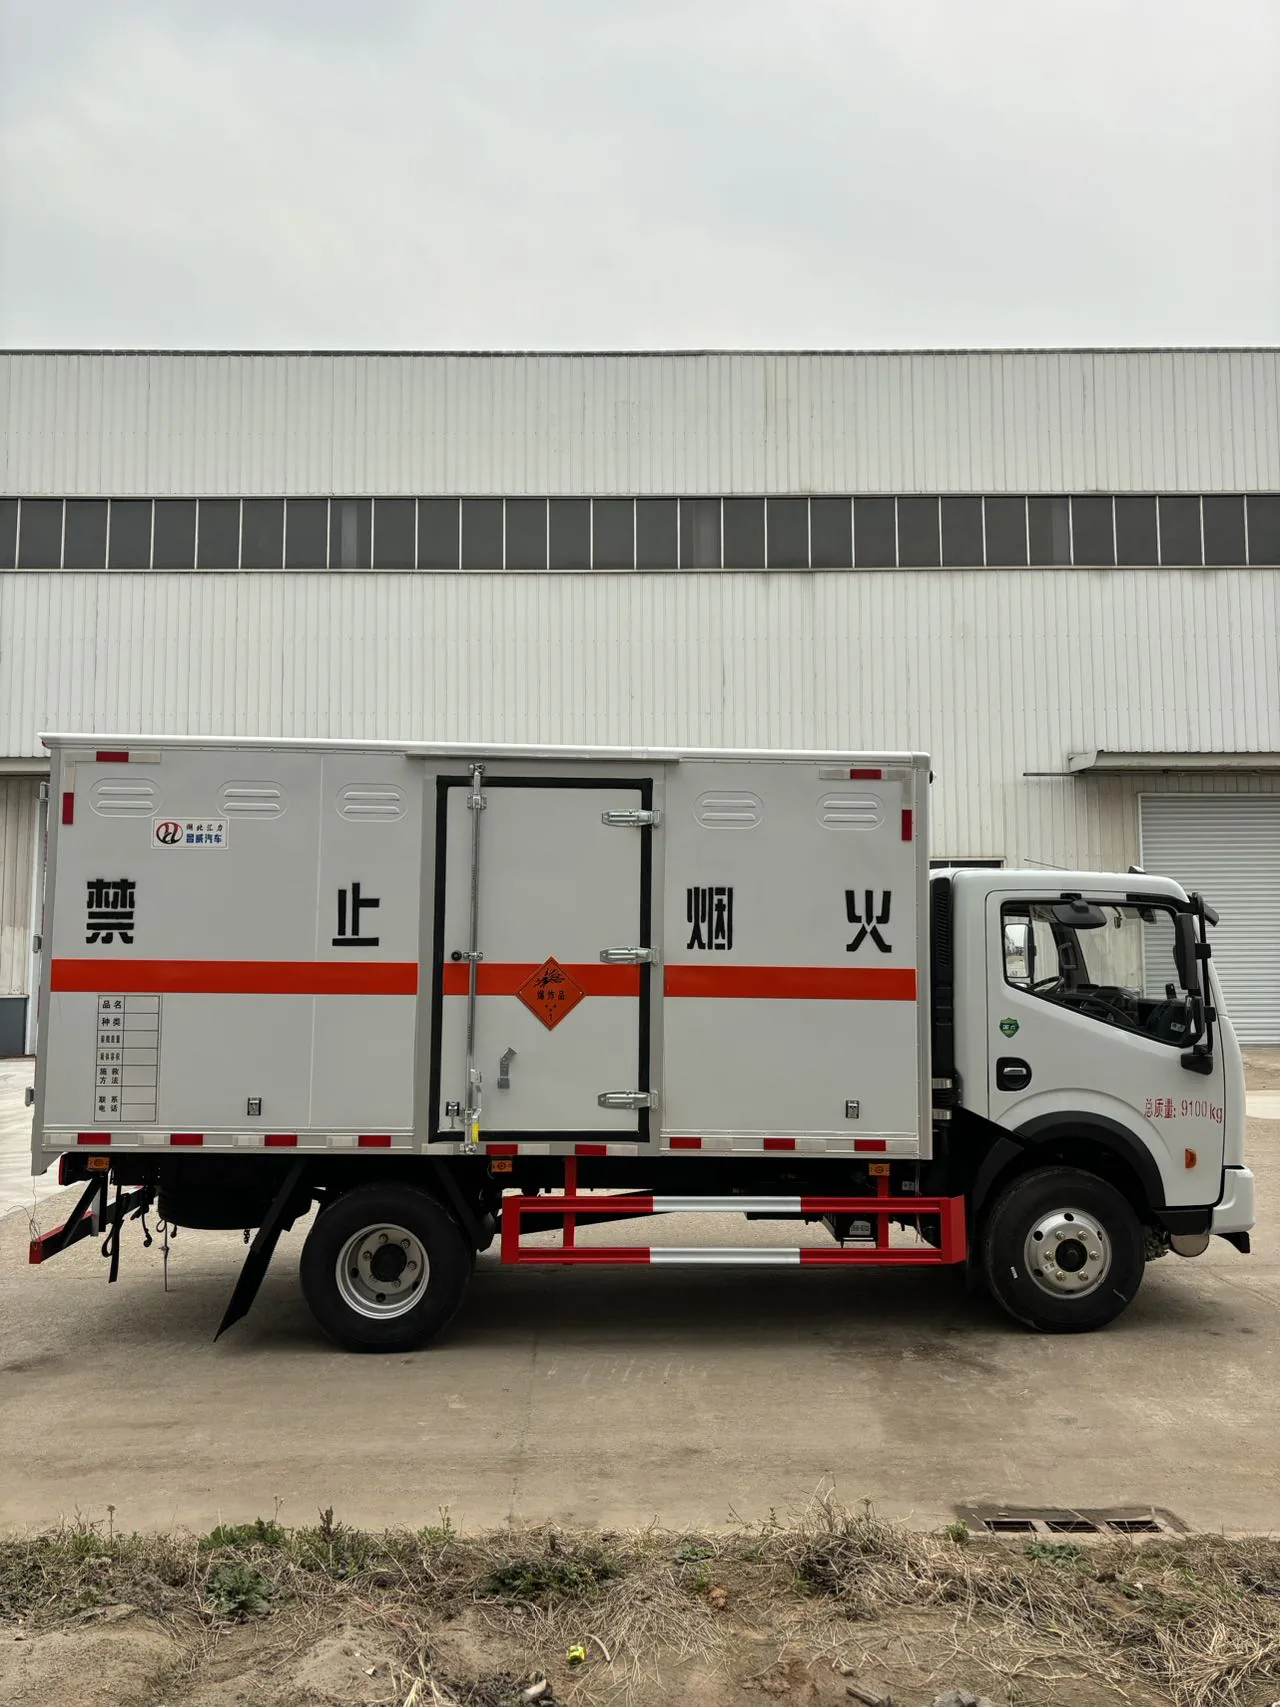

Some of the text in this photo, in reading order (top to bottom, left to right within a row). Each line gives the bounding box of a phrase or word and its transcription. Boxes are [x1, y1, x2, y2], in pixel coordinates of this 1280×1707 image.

[186, 824, 223, 832] 湖北汇力
[186, 833, 222, 844] 昌威汽车
[536, 990, 566, 1001] 爆炸品
[102, 1000, 122, 1009] 品名
[101, 1017, 121, 1027] 种类
[98, 1095, 118, 1104] 联系
[98, 1104, 118, 1113] 电话
